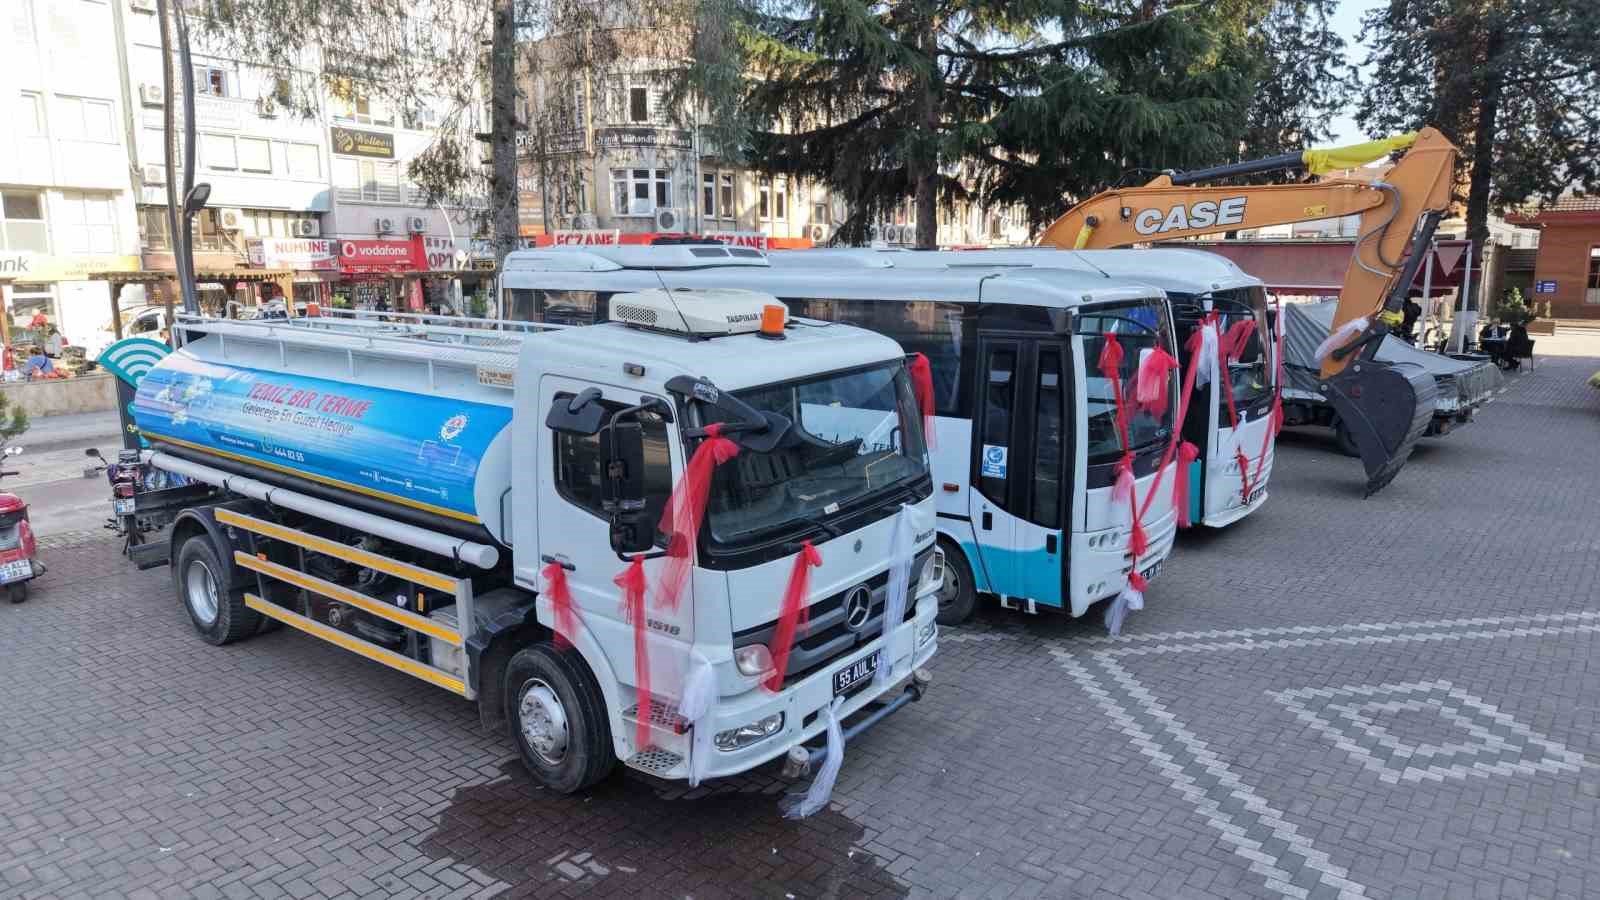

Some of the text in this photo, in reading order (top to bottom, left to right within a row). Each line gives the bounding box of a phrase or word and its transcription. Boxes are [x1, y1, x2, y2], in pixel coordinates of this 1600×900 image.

[1134, 196, 1248, 236] CASE
[275, 240, 329, 254] NUMUNE
[359, 245, 407, 256] vodafone
[317, 393, 374, 419] TERME
[839, 670, 850, 688] 55
[853, 660, 869, 680] AUL
